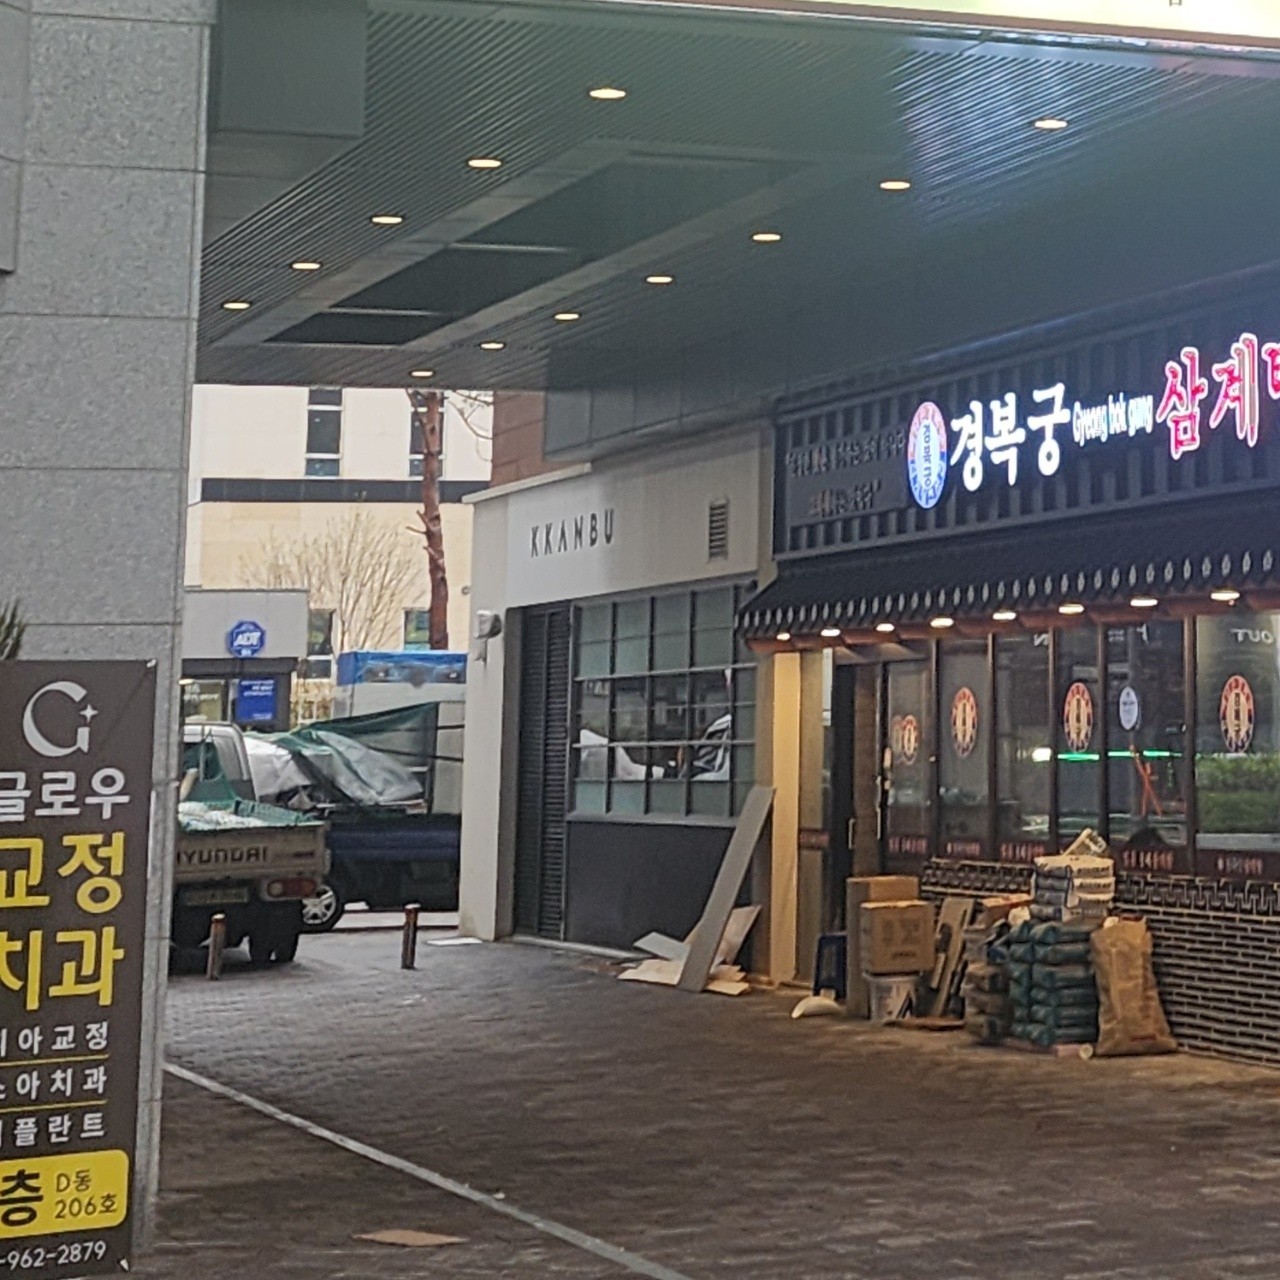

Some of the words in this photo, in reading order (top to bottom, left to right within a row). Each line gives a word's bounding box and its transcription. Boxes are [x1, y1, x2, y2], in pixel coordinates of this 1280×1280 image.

[950, 382, 1071, 492] 경복궁
[529, 508, 615, 558] KKANBU
[0, 768, 130, 821] 글로우
[0, 831, 125, 914] 교정
[0, 926, 124, 1010] 치과
[0, 1065, 107, 1101] 아치과
[0, 1112, 105, 1148] 플란트
[56, 1169, 92, 1193] D동
[55, 1193, 118, 1220] 206호
